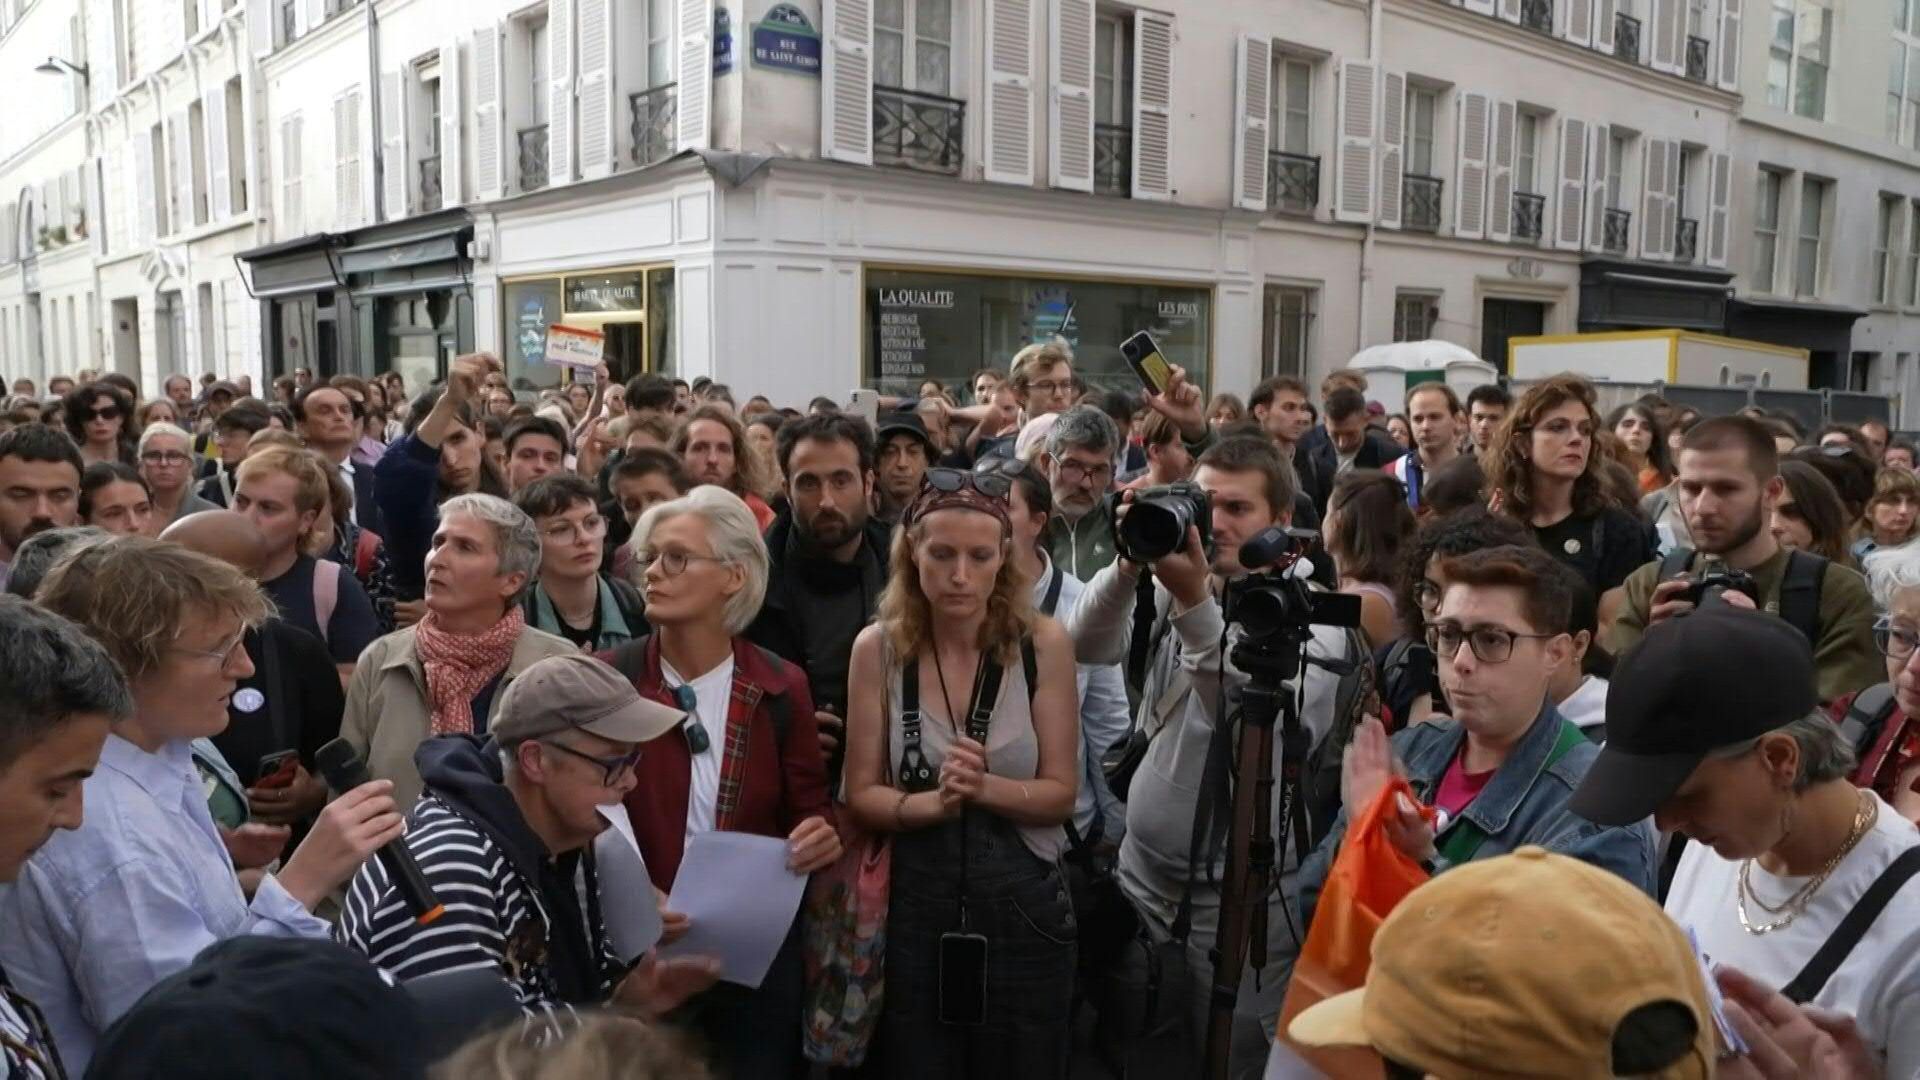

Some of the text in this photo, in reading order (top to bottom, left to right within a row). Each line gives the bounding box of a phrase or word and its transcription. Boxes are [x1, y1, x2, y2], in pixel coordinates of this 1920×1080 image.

[780, 39, 797, 50] RUE
[756, 47, 768, 59] DE
[880, 287, 955, 307] LA QUALITE
[1158, 301, 1198, 317] LES PRIX
